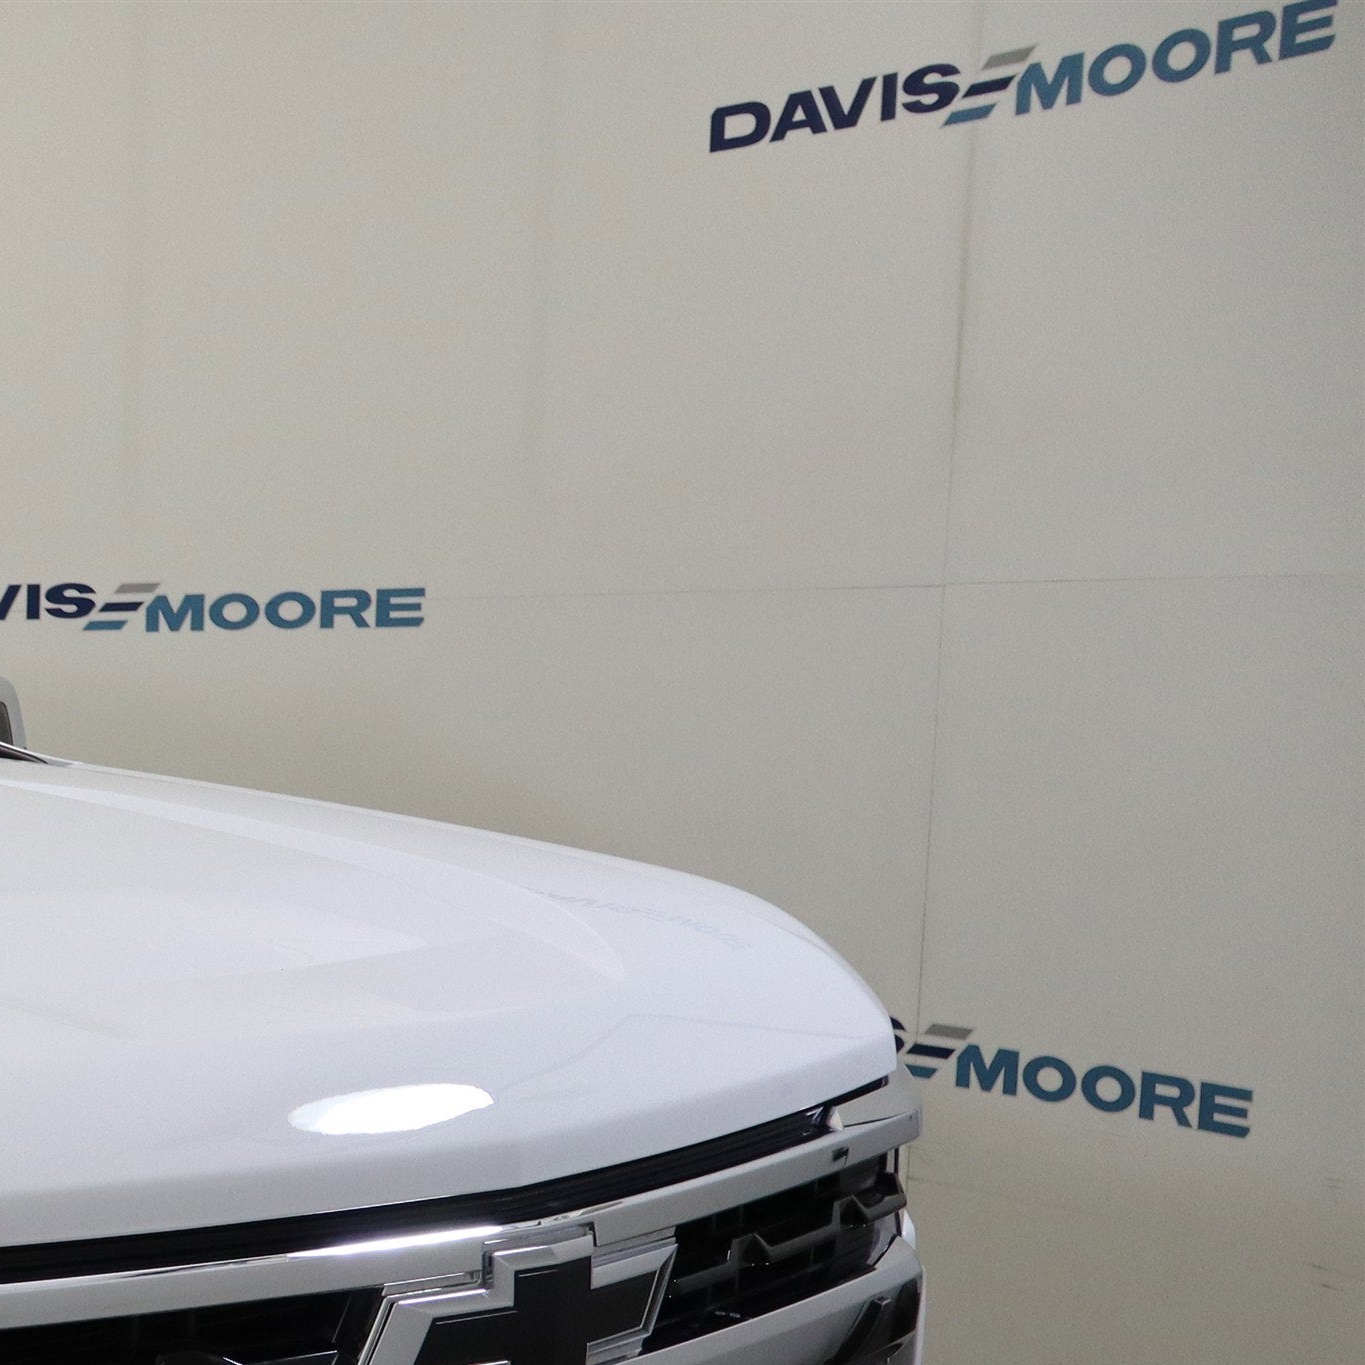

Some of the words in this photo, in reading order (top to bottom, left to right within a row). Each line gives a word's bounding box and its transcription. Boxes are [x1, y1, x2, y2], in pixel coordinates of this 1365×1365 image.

[709, 62, 963, 153] DAVIS
[1014, 0, 1340, 116] MOORE
[145, 587, 427, 633] MOORE
[954, 1042, 1255, 1140] MOORE
